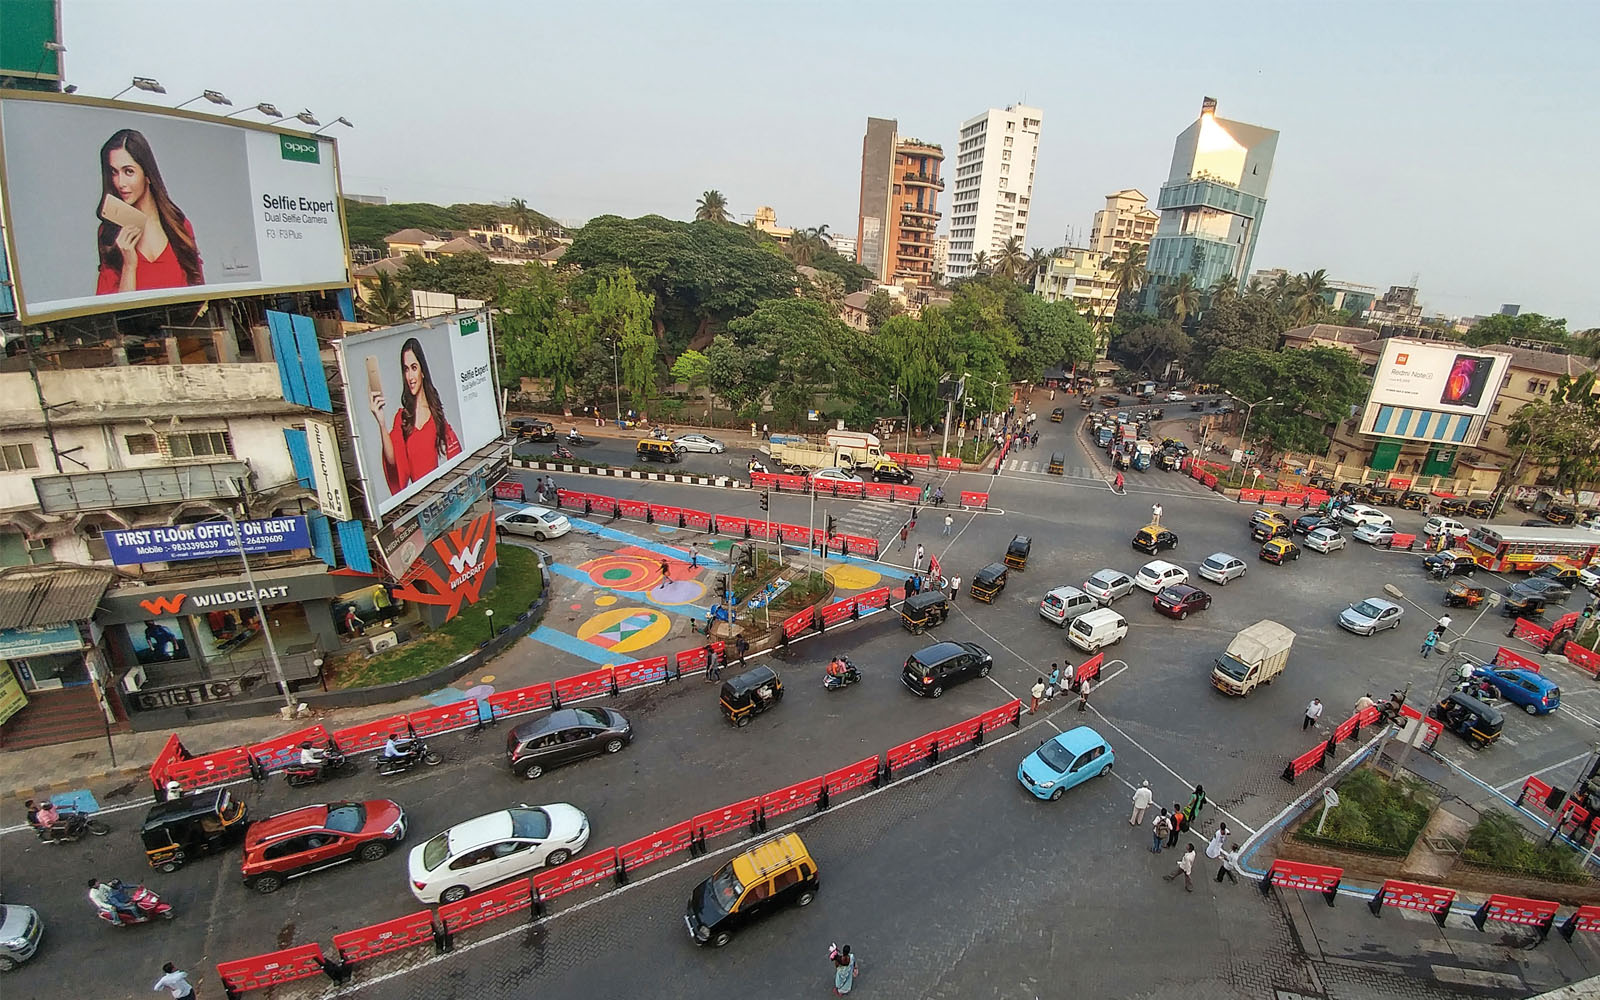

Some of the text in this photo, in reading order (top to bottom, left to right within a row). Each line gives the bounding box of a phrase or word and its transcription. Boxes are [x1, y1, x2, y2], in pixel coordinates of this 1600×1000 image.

[284, 142, 316, 153] oppo
[262, 194, 335, 214] Selfie Expert
[264, 212, 328, 224] Dual Selfie Camera
[460, 363, 489, 383] Selfie Expert
[314, 423, 336, 511] SELECTION
[115, 531, 152, 547] FIRST
[154, 527, 195, 543] FLOOR
[244, 521, 263, 535] ON
[265, 518, 297, 534] RENT
[385, 537, 401, 554] HIGH
[400, 521, 419, 542] SIERRA
[137, 544, 164, 555] Mobile
[171, 540, 219, 552] 9833398339
[246, 535, 284, 545] 26439609
[450, 562, 486, 590] WILDCRAFT
[192, 585, 289, 608] WILDCRAFT
